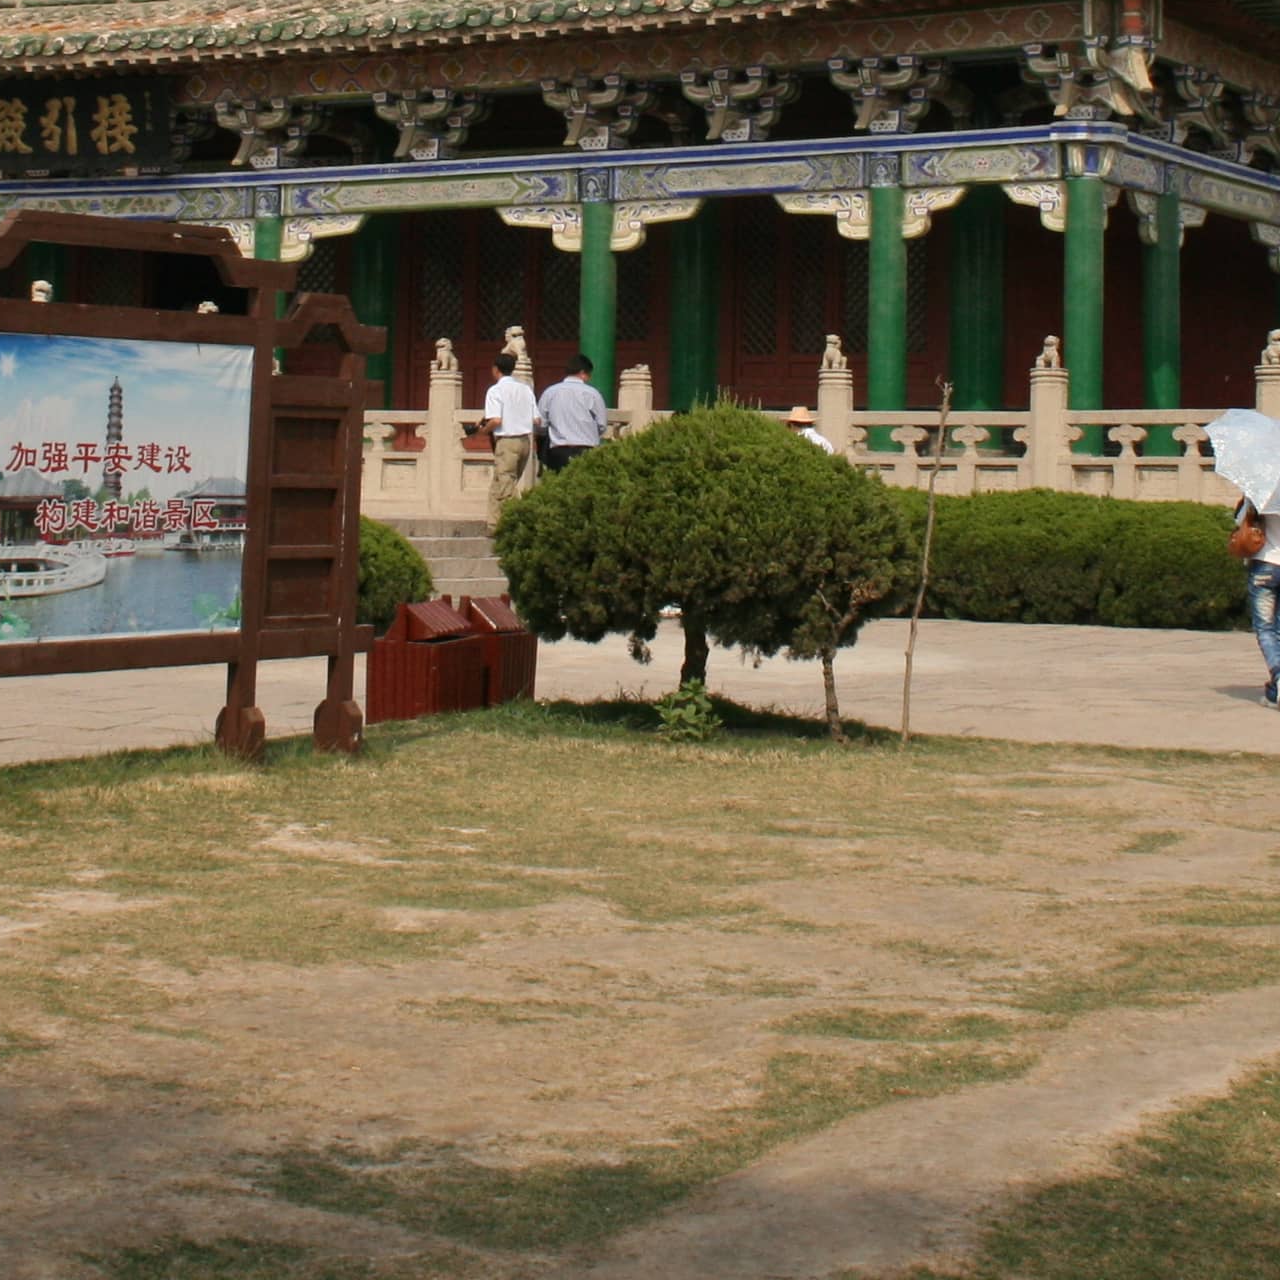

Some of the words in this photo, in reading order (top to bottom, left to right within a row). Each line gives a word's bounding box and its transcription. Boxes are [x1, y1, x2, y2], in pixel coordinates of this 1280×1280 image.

[5, 441, 192, 474] 加强平安建设
[35, 499, 219, 532] 构建和谐景区
